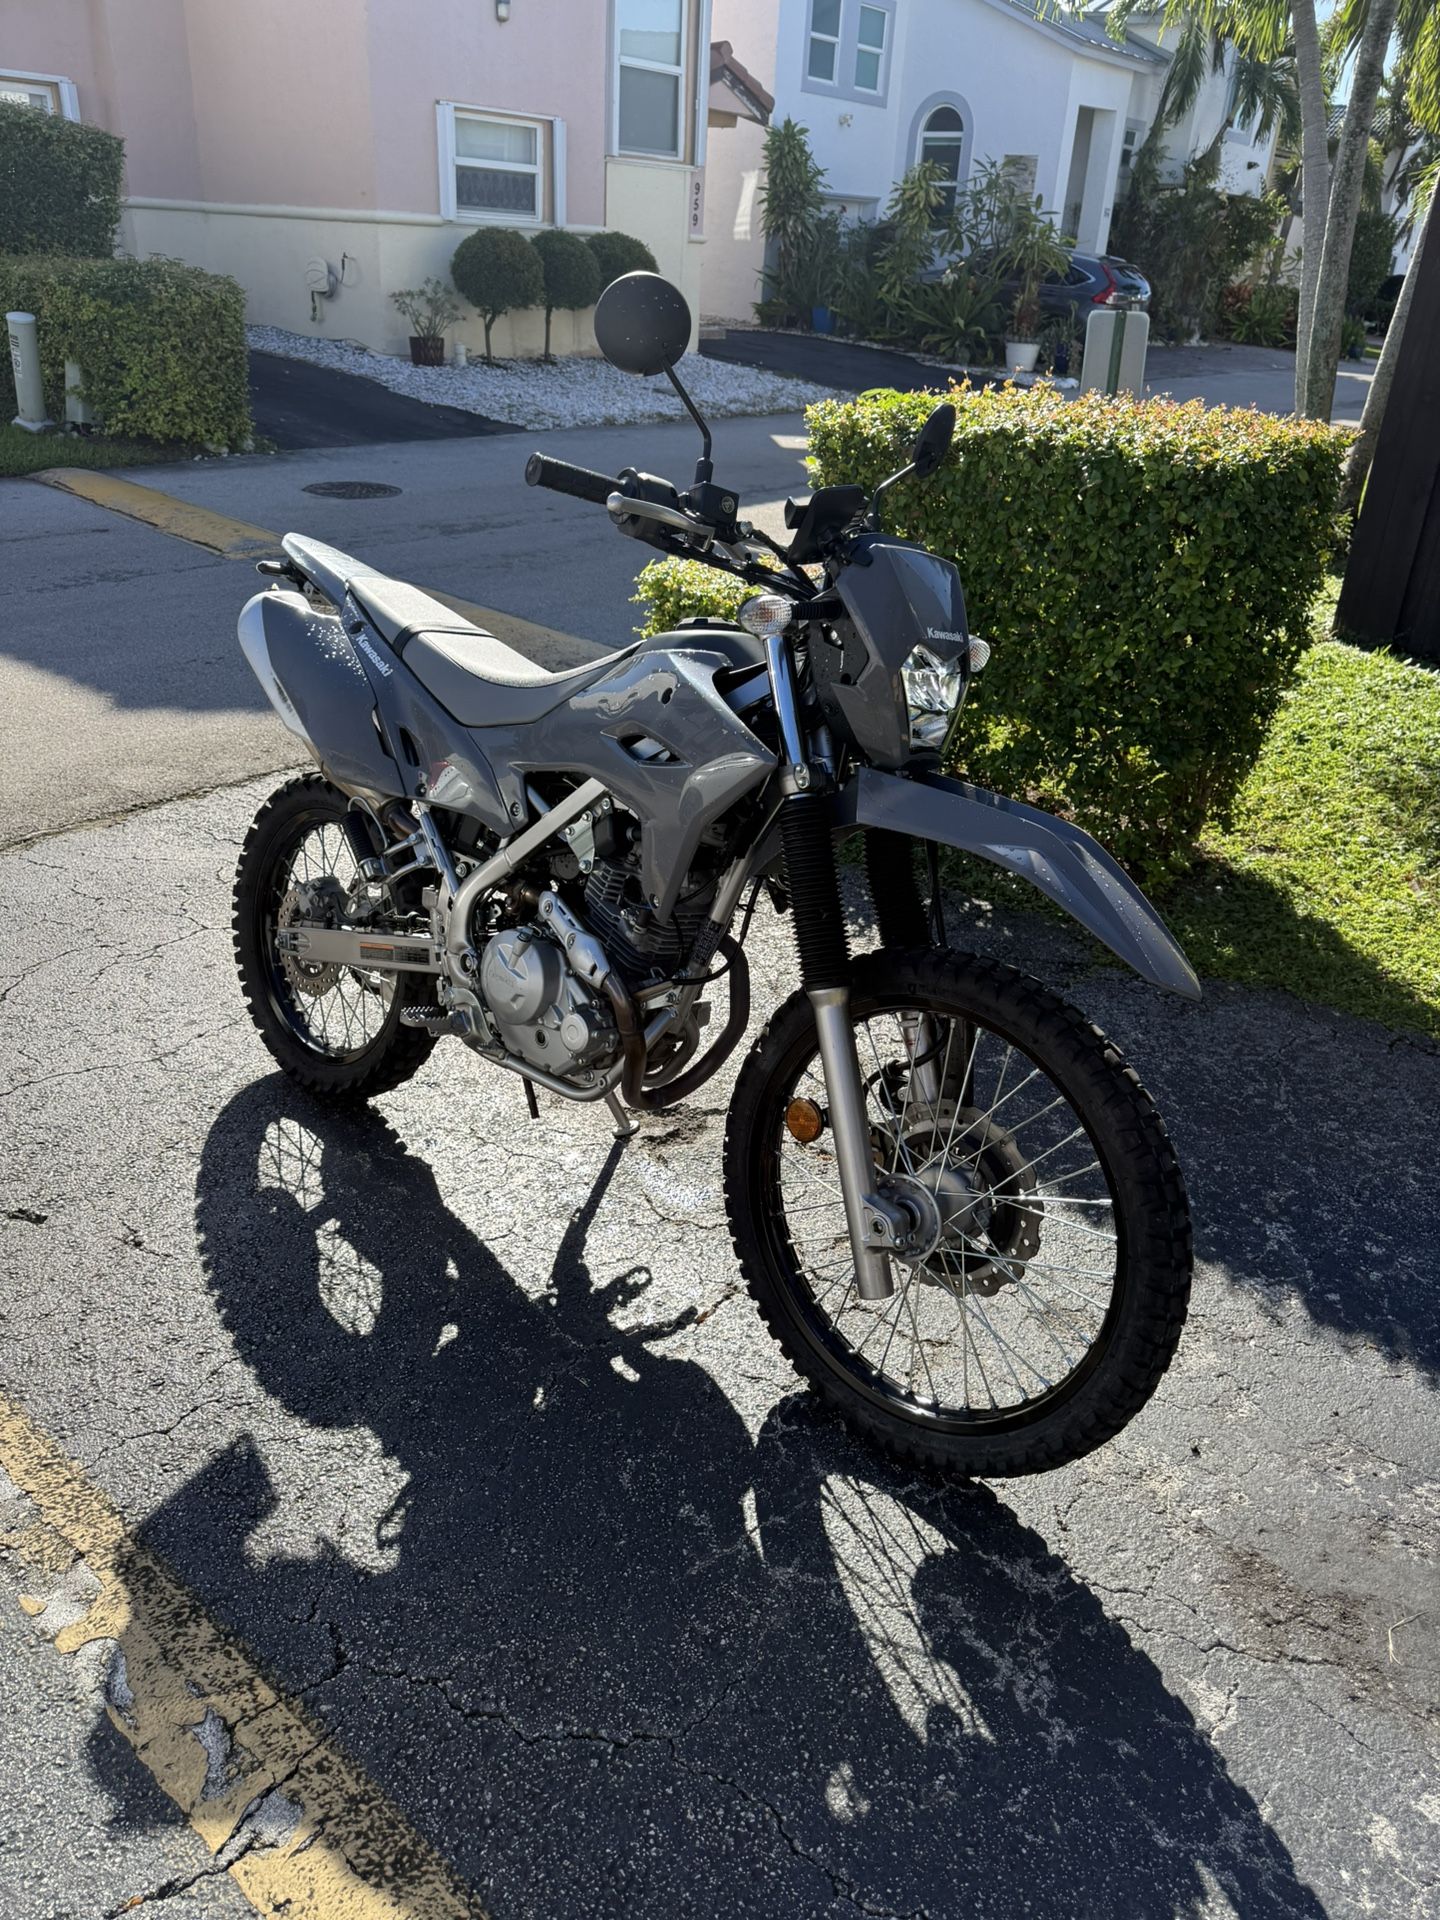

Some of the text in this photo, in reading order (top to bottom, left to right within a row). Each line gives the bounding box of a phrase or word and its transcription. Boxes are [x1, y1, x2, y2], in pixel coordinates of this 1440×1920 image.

[692, 182, 700, 227] 959
[355, 633, 394, 677] Kawasaki
[927, 627, 964, 643] Kawasaki
